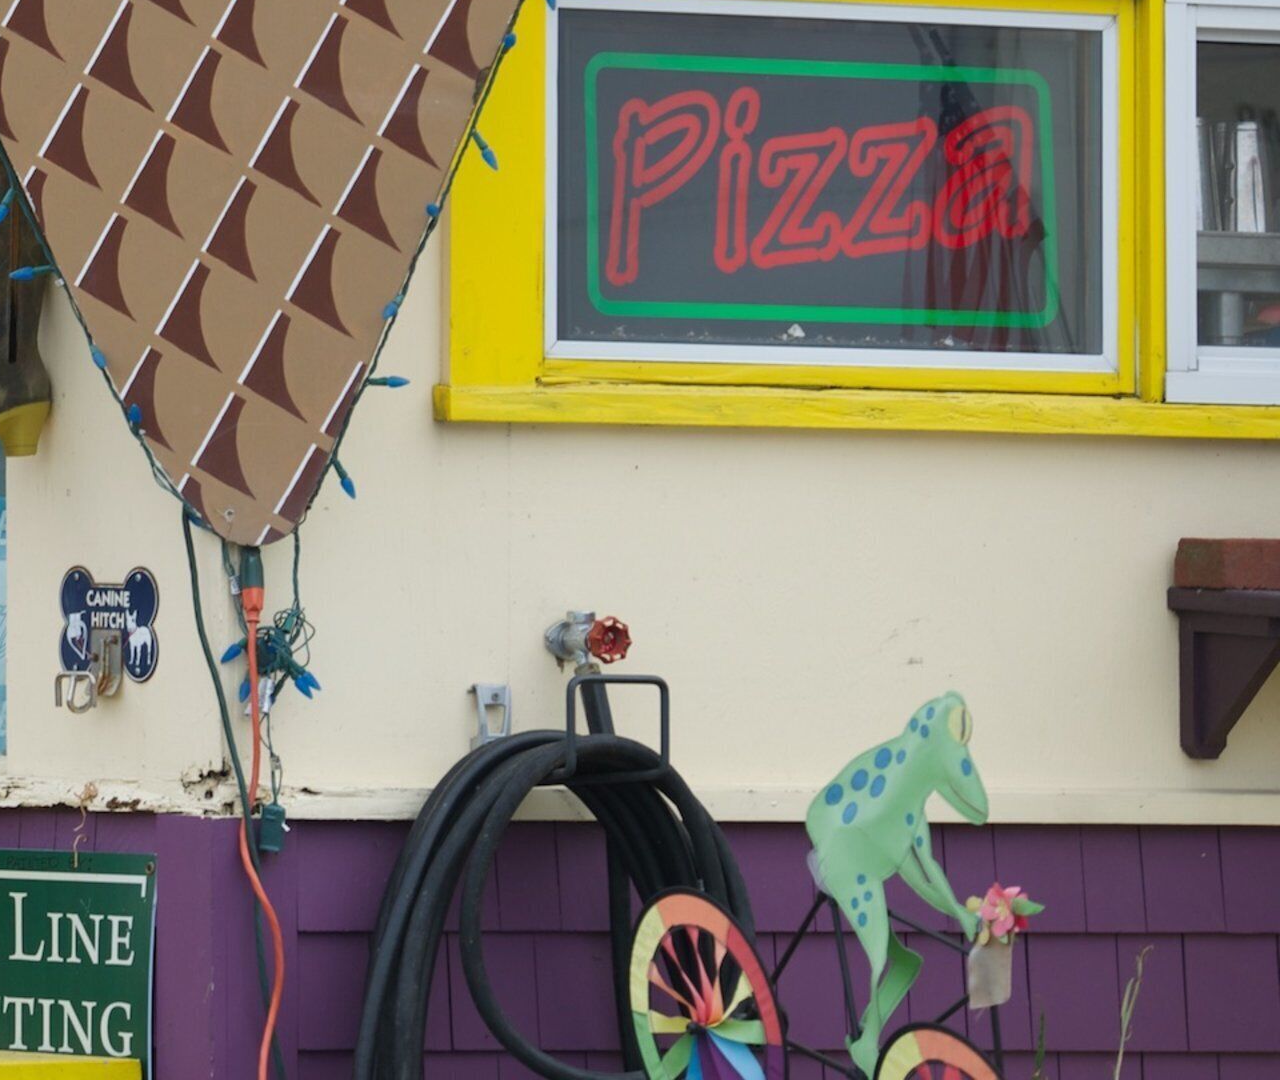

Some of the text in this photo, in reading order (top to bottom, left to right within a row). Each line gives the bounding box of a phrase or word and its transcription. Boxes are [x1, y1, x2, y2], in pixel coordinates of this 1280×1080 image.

[606, 86, 1034, 287] Pizza
[86, 590, 131, 607] CANINE
[91, 611, 125, 629] HITCH
[8, 892, 135, 967] LINE
